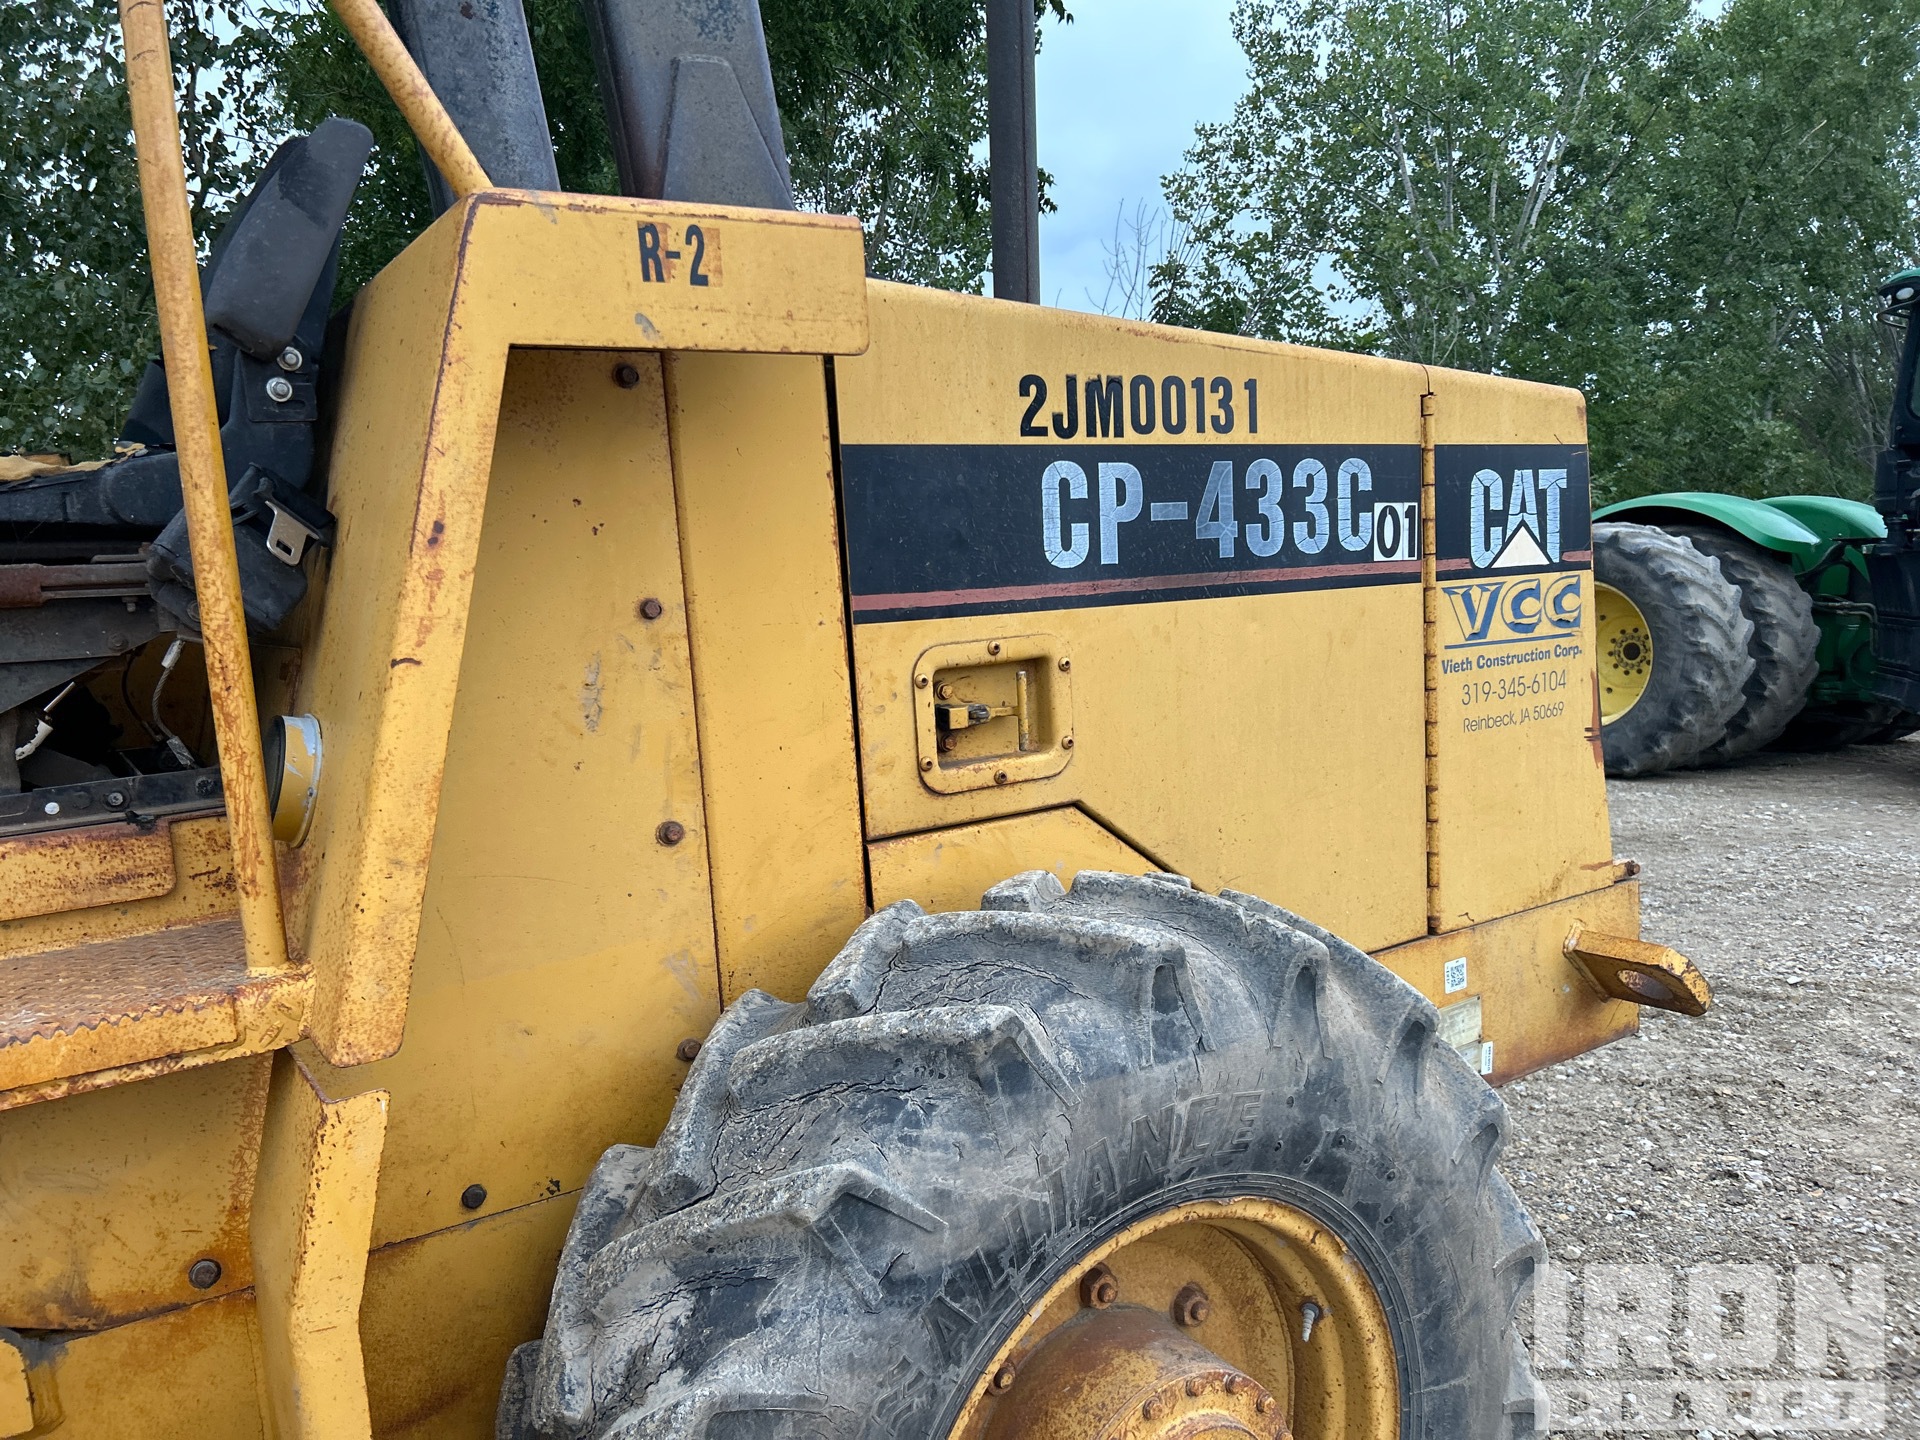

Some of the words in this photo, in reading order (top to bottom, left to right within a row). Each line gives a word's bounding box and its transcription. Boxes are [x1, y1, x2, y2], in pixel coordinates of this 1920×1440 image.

[637, 223, 709, 287] R-2
[1018, 373, 1259, 440] 2JM00131
[1041, 457, 1373, 569] CP-433C
[1376, 504, 1417, 558] 01
[1470, 468, 1568, 569] CAT
[1441, 574, 1582, 642] VCC
[1441, 656, 1473, 675] Vieth
[1476, 647, 1551, 670] Construction
[1553, 643, 1583, 660] Corp.
[1461, 668, 1567, 706] 319-345-6104
[1463, 710, 1518, 733] Reinbeck,
[1533, 701, 1565, 721] 50669
